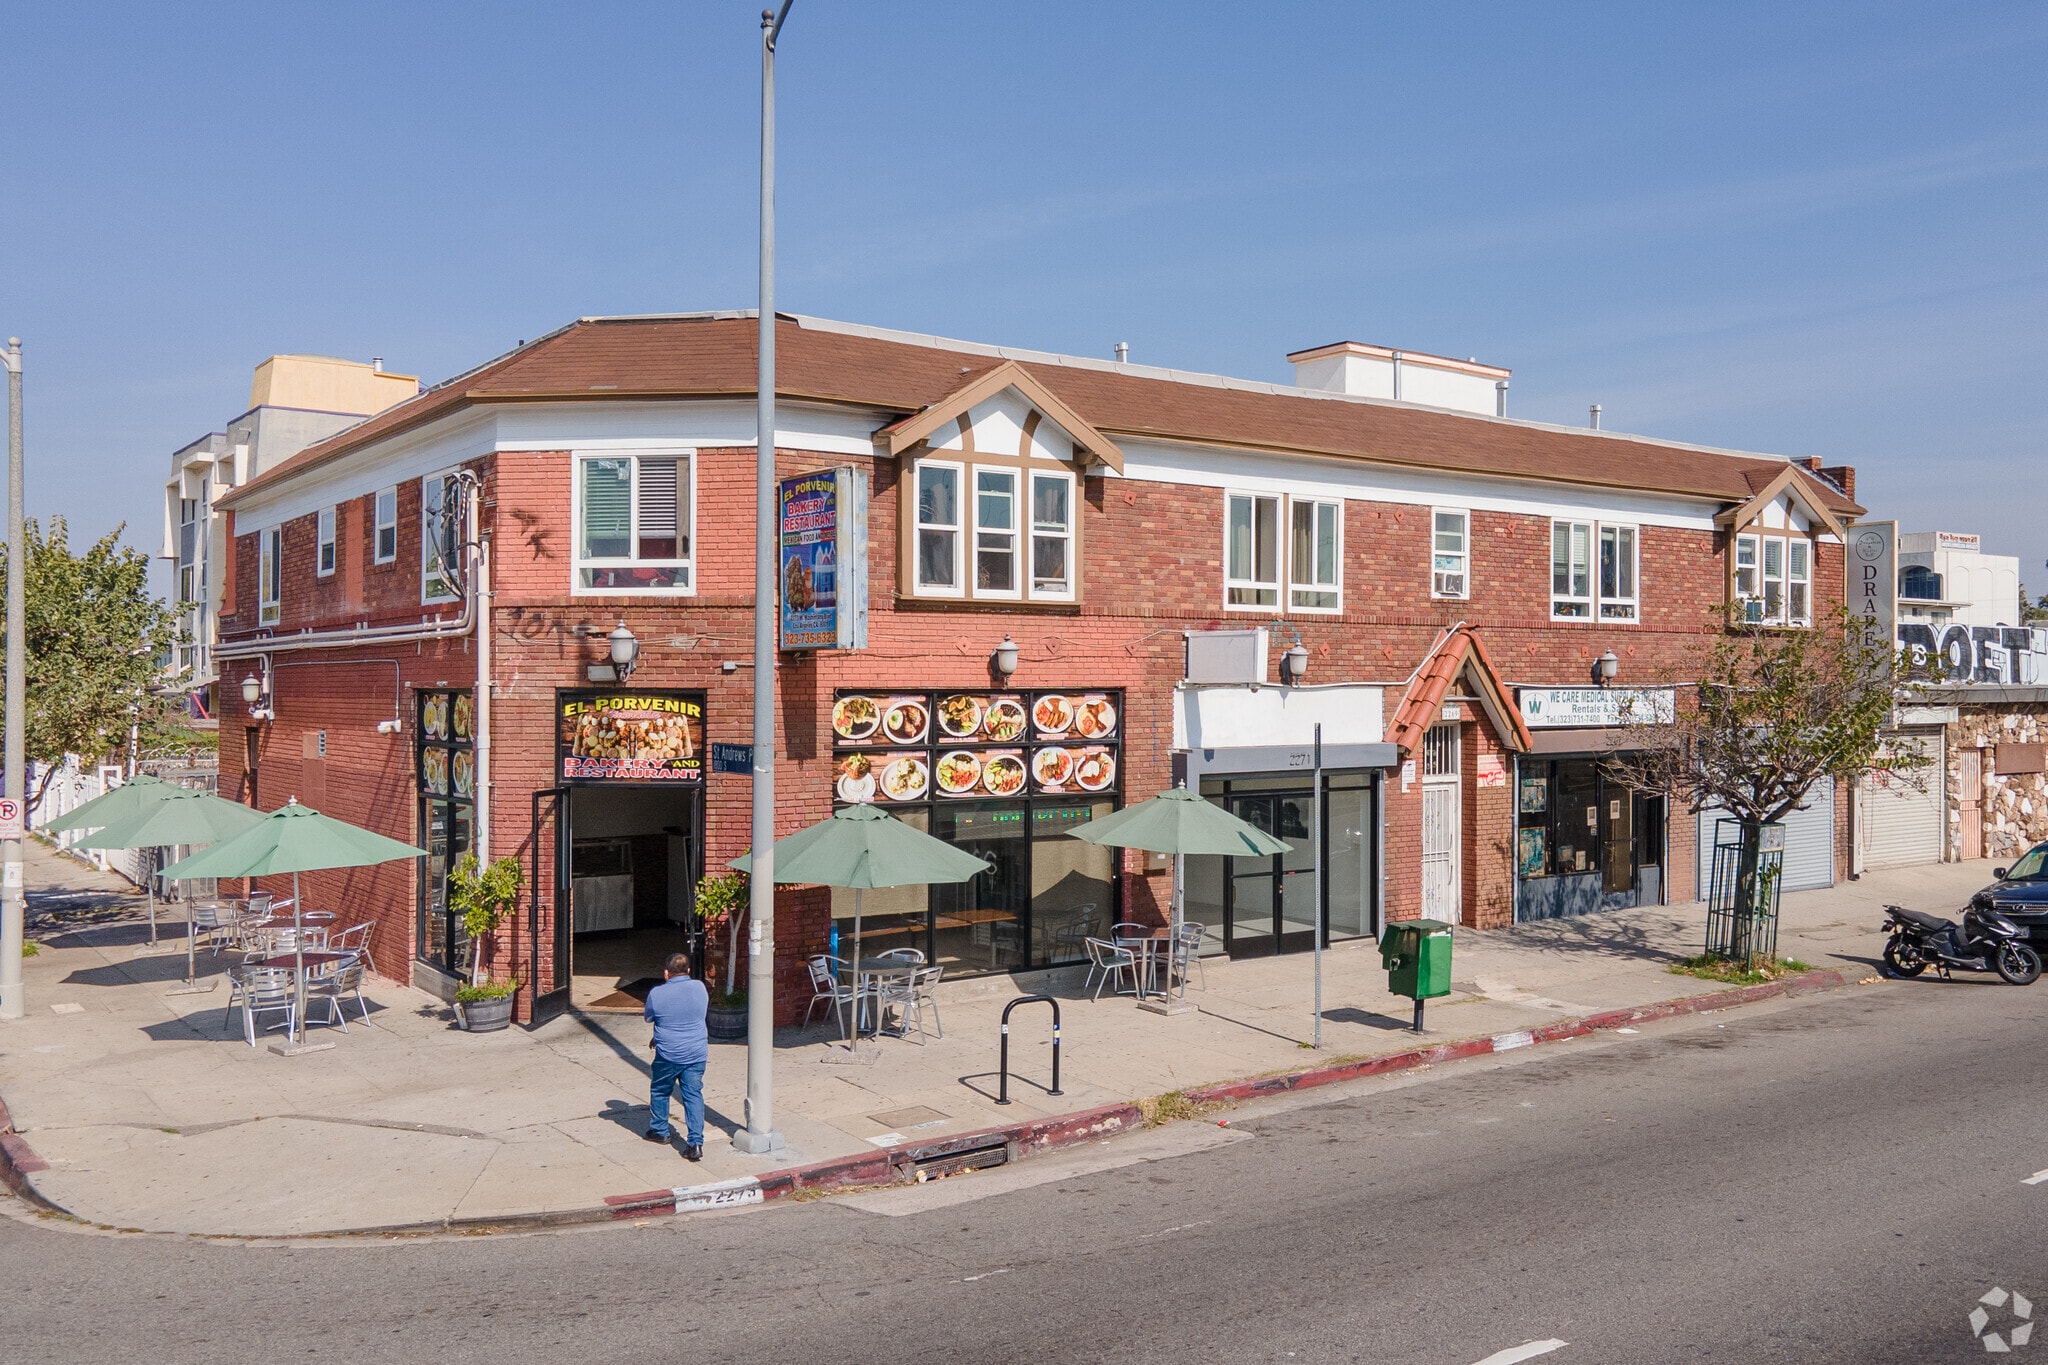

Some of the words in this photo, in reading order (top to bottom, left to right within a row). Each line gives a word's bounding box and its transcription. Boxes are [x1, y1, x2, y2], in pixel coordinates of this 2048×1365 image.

[784, 489, 794, 503] EL
[795, 480, 836, 495] PORVENIR
[787, 498, 826, 517] BAKERY
[784, 511, 836, 533] RESTAURANT
[804, 532, 815, 542] FOOD
[785, 632, 837, 645] 323-735-6323
[1550, 691, 1560, 703] WE
[1562, 691, 1579, 703] CARE
[1581, 691, 1608, 703] MEDICAL
[564, 702, 589, 717] EL
[595, 698, 701, 718] PORVENIR
[1572, 704, 1600, 714] Rentals
[1603, 704, 1609, 713] &
[713, 744, 720, 760] St
[722, 745, 746, 762] Andrews
[749, 748, 754, 763] P
[1289, 753, 1311, 767] 2271
[565, 758, 668, 769] BAKERY
[672, 760, 700, 768] AND
[723, 761, 727, 771] S
[565, 767, 701, 779] RESTAURANT
